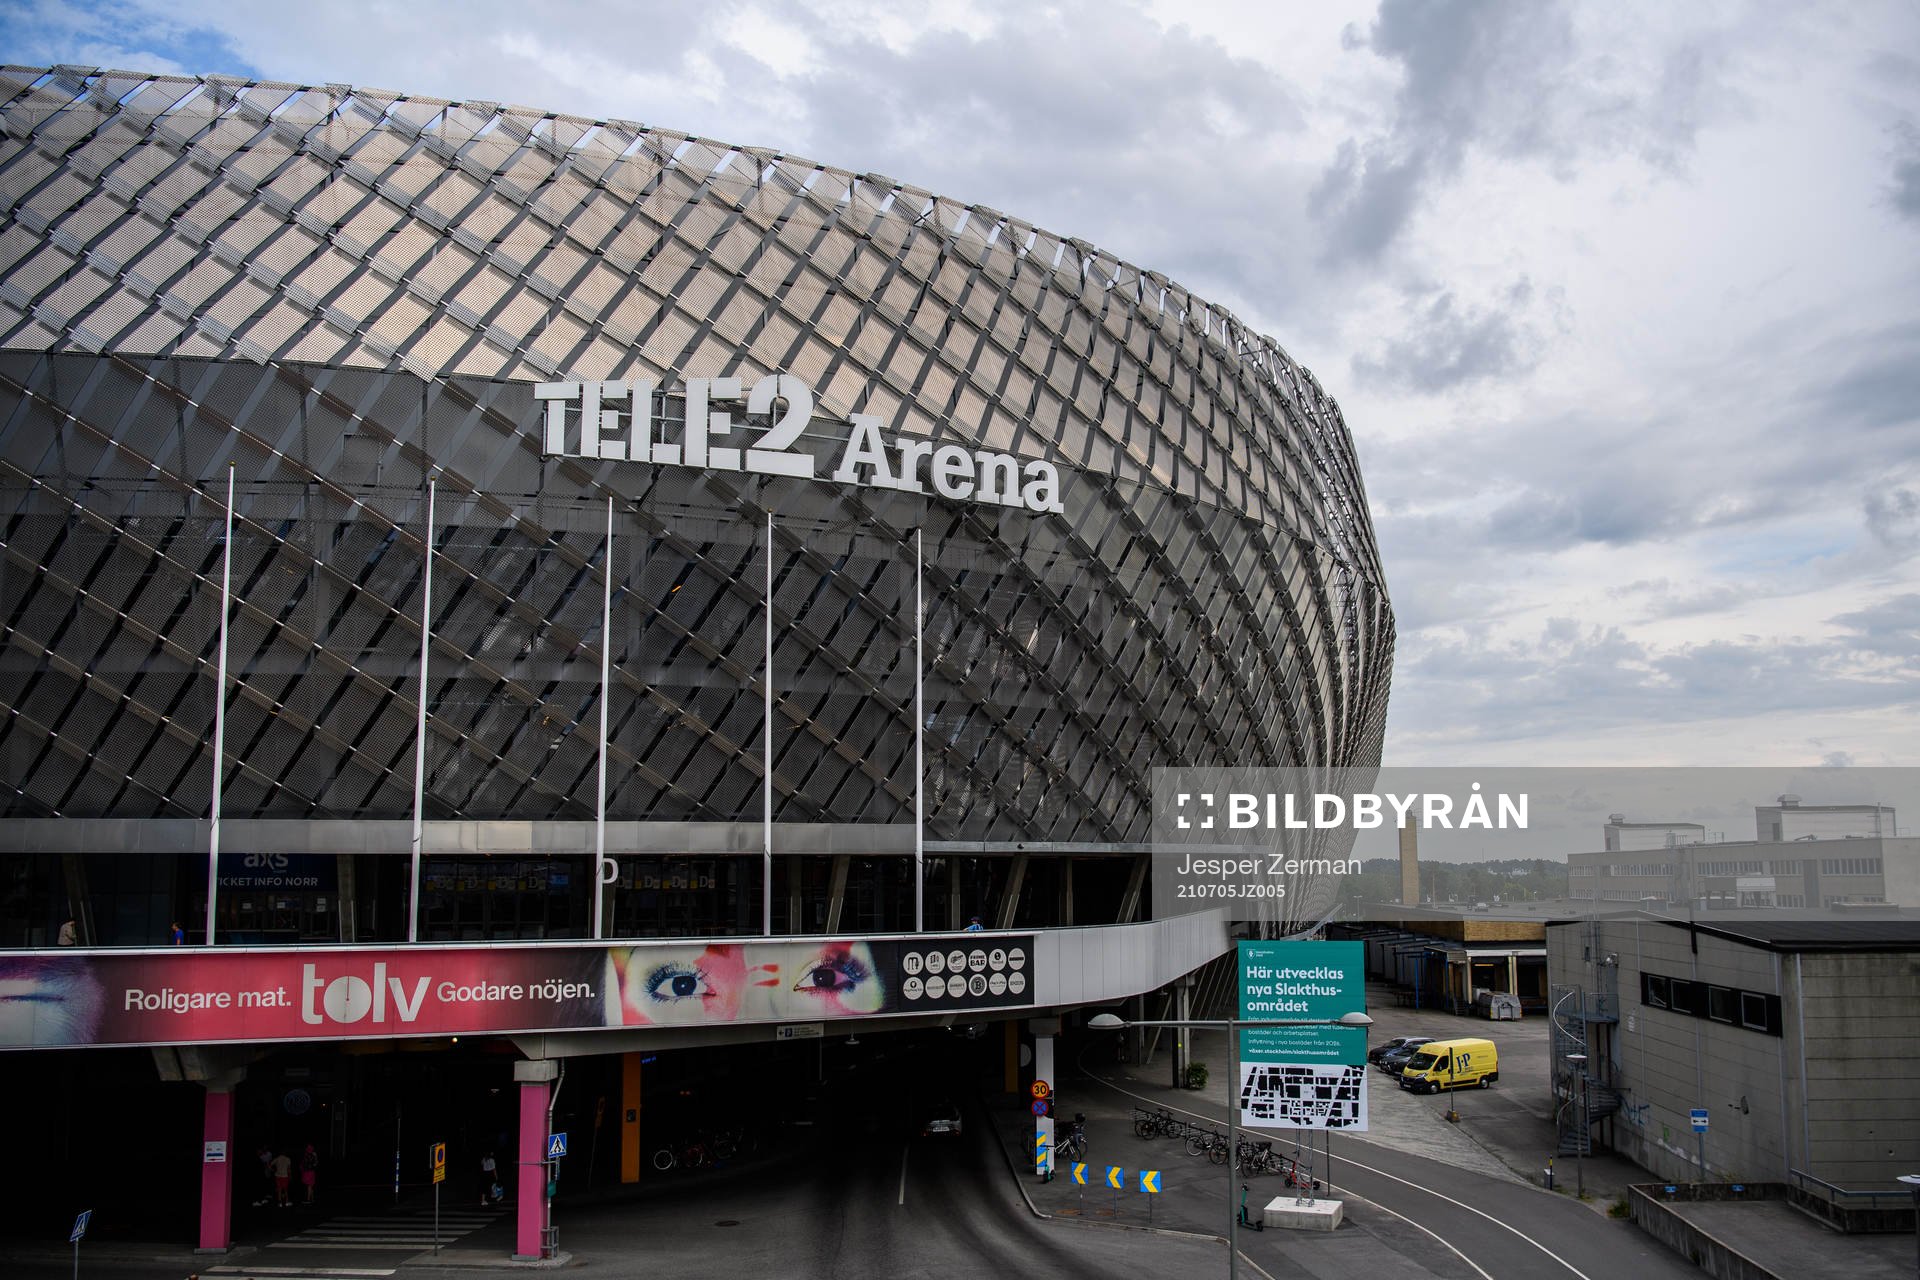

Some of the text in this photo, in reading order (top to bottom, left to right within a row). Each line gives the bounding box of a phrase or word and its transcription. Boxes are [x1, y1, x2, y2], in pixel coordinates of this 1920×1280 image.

[535, 374, 1064, 513] TELE2 Arena
[215, 877, 319, 887] ICKET INFO NORR
[1246, 966, 1344, 980] Här utvecklas
[302, 962, 432, 1025] tolv
[437, 979, 595, 1002] Godare nöjen.
[1247, 983, 1342, 997] nya Slakthus-
[125, 987, 291, 1013] Roligare mat.
[1247, 998, 1308, 1012] området
[1034, 1085, 1047, 1095] 30
